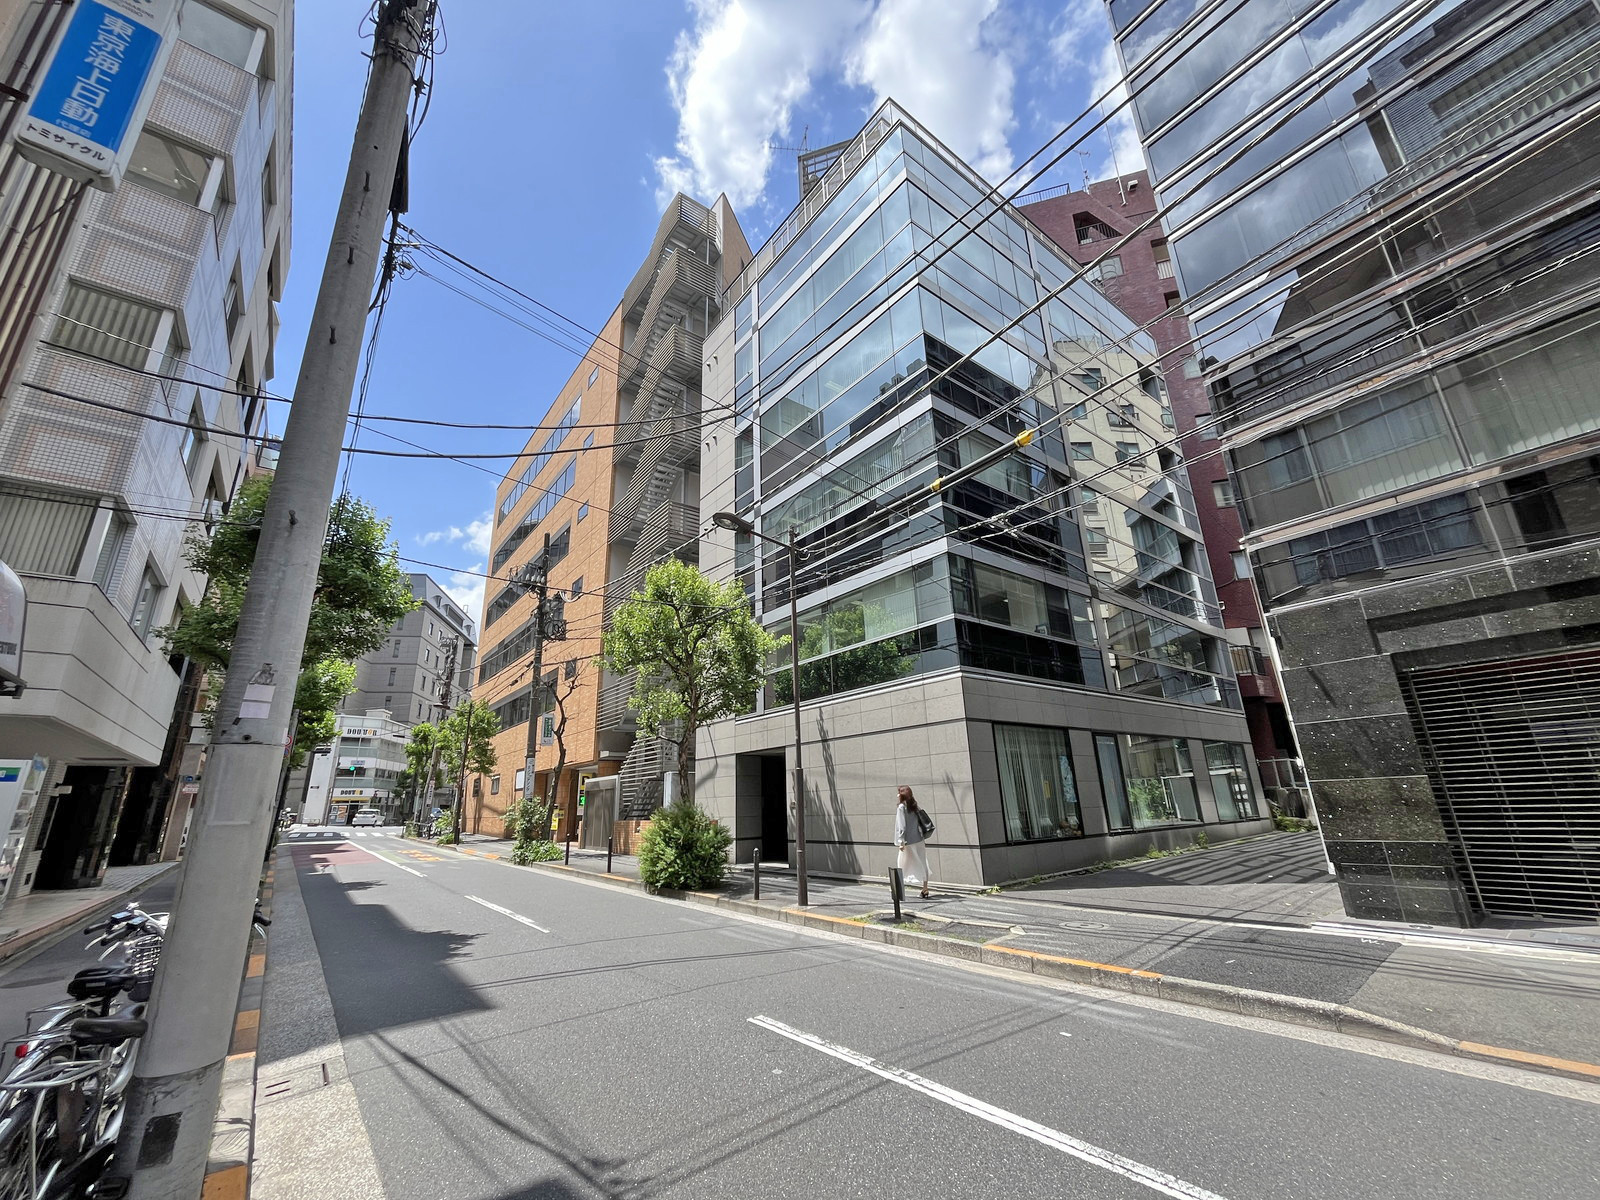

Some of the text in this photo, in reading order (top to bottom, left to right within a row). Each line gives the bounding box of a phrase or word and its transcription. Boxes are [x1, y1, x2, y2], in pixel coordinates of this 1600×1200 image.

[60, 12, 136, 127] 東京海上日動
[26, 123, 106, 161] トミサイクル
[347, 728, 378, 736] DOUTOR
[340, 789, 364, 797] DOUTOR
